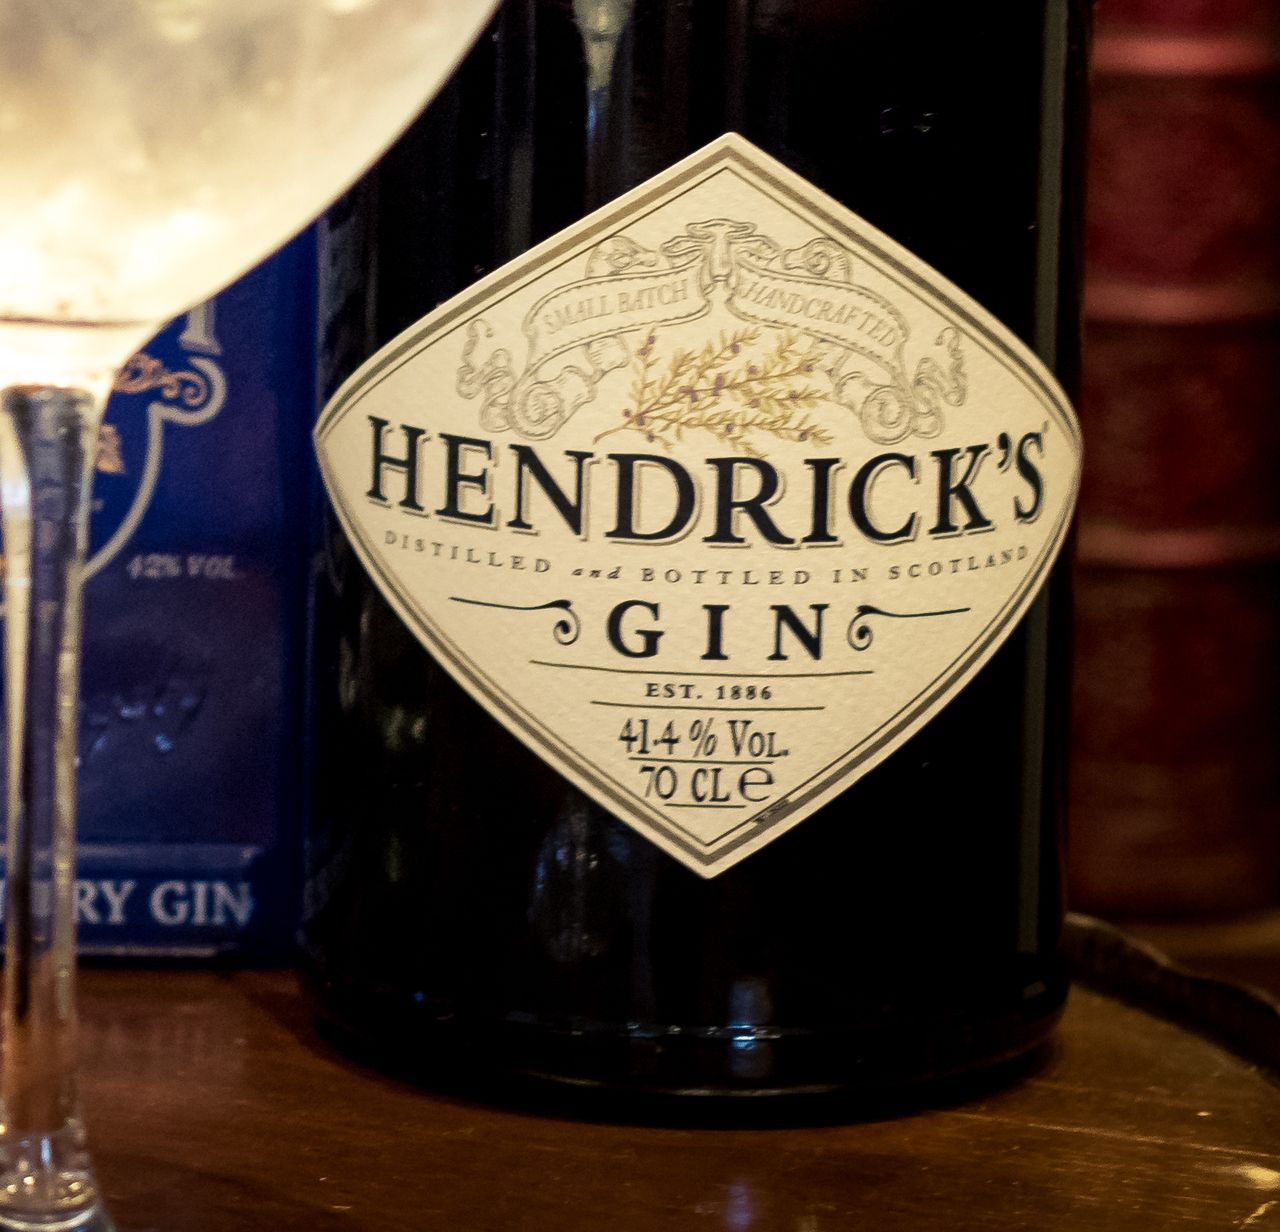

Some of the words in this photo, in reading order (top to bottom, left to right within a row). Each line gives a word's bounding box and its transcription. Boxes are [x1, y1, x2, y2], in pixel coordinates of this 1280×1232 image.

[543, 294, 608, 336] SMALL
[616, 277, 689, 314] BATCH
[740, 281, 899, 348] HANDCRAFTED
[365, 414, 1047, 551] HENDRICK'S
[383, 529, 553, 574] DISTILLED
[570, 566, 622, 580] and
[640, 568, 811, 586] BOTTLED
[832, 568, 869, 584] IN
[887, 544, 1030, 581] SCOTLAND
[606, 599, 831, 661] GIN
[644, 682, 704, 700] EST.
[715, 684, 773, 701] 1886
[638, 765, 679, 801] 70
[149, 878, 255, 927] GIN
